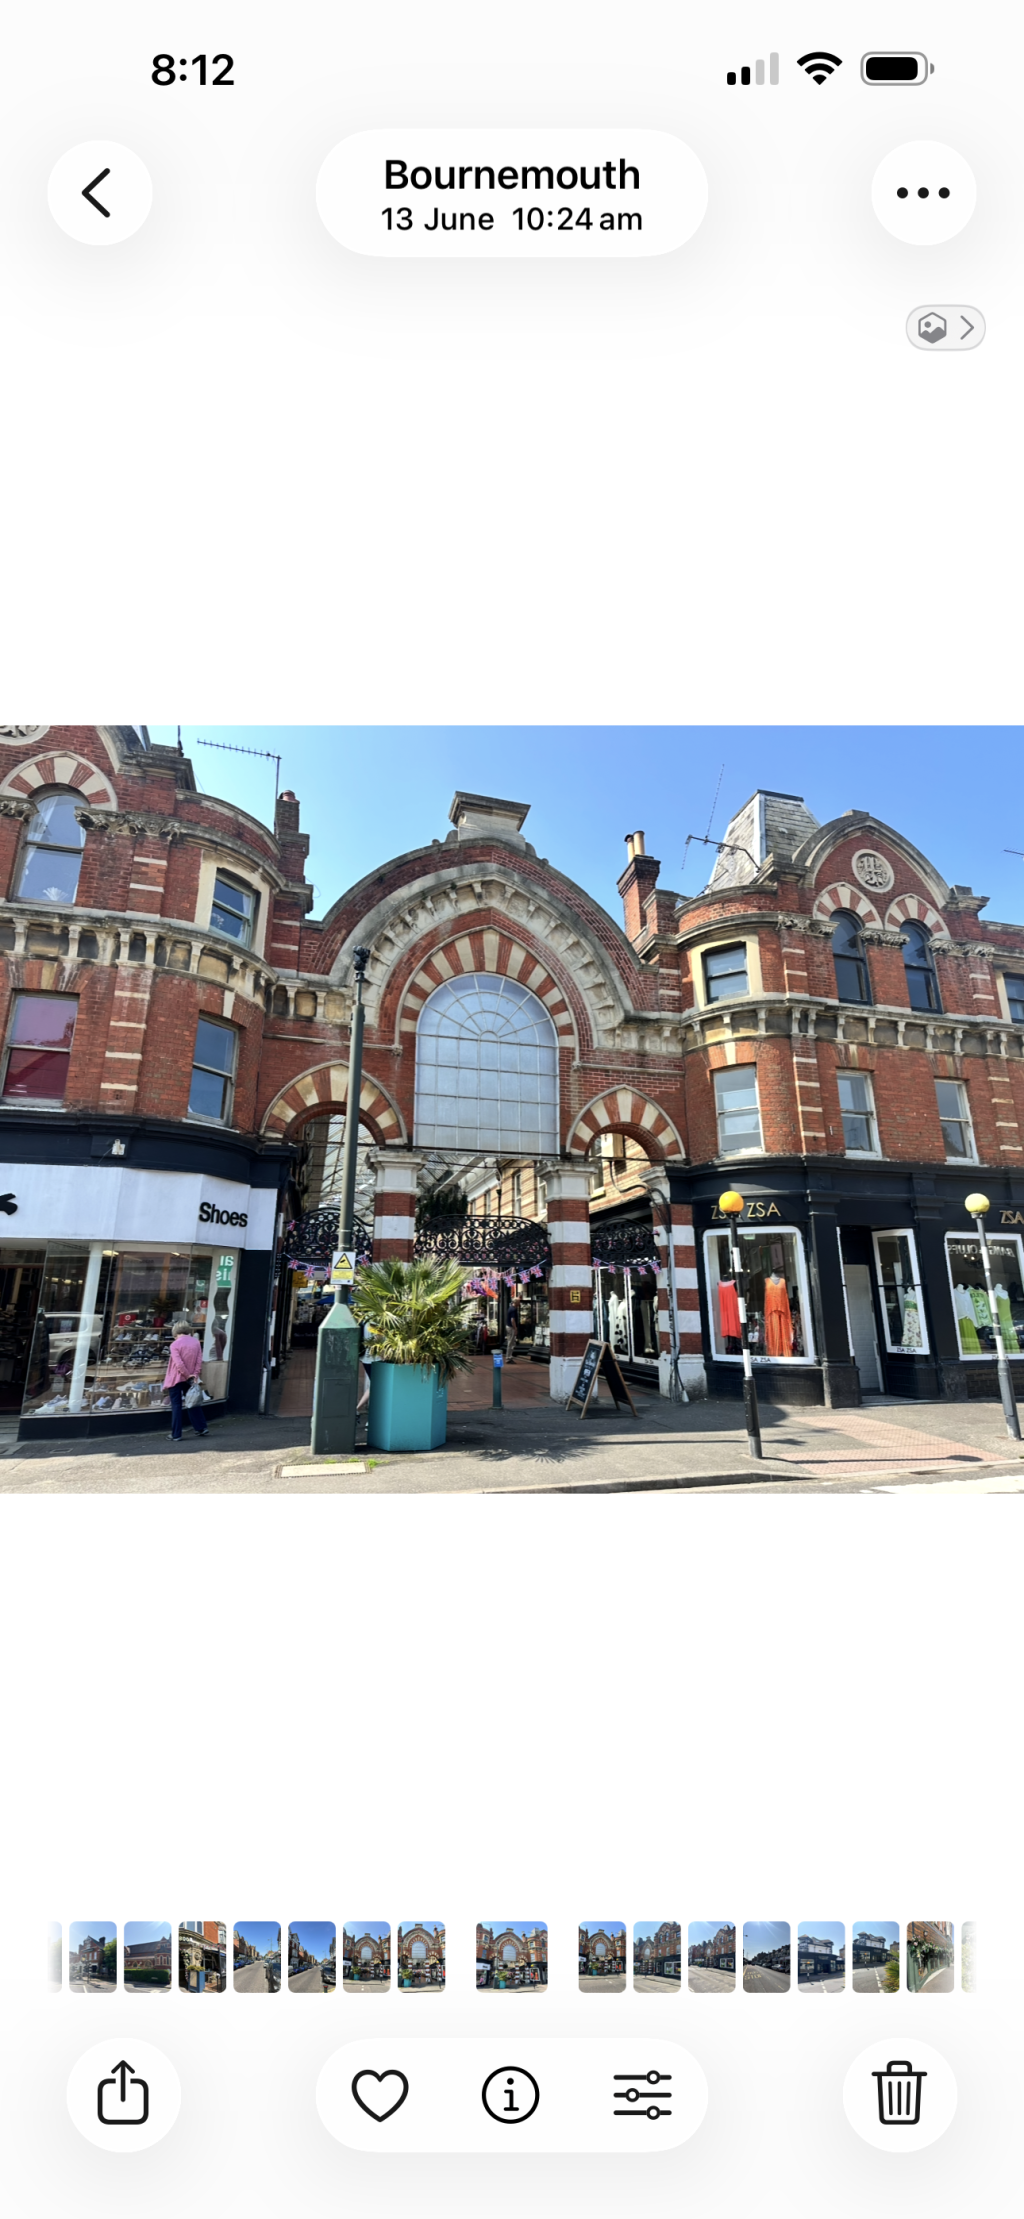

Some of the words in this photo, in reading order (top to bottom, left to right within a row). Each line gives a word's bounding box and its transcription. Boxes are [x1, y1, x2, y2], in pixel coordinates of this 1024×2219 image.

[151, 53, 235, 87] 8:12
[385, 158, 640, 190] Bournemouth
[381, 207, 412, 231] 13
[424, 207, 495, 231] June
[199, 1201, 248, 1228] Shoes
[746, 1202, 782, 1218] ZSA
